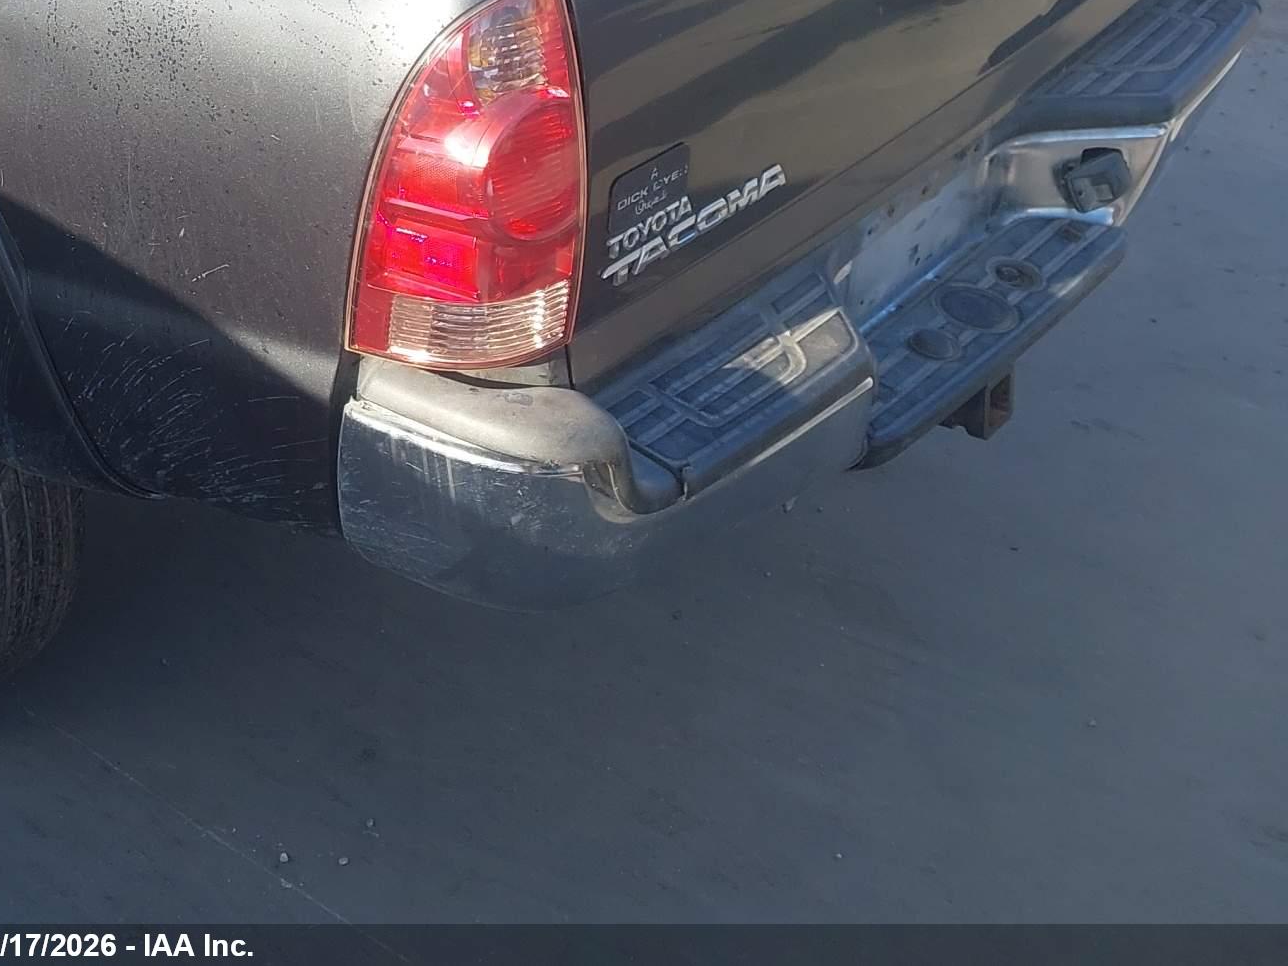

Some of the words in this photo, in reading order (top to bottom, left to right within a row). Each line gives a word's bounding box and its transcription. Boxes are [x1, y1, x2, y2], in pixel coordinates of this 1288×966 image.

[600, 163, 787, 286] TACOMA
[606, 195, 692, 259] TOYOTA
[617, 185, 649, 211] DICK
